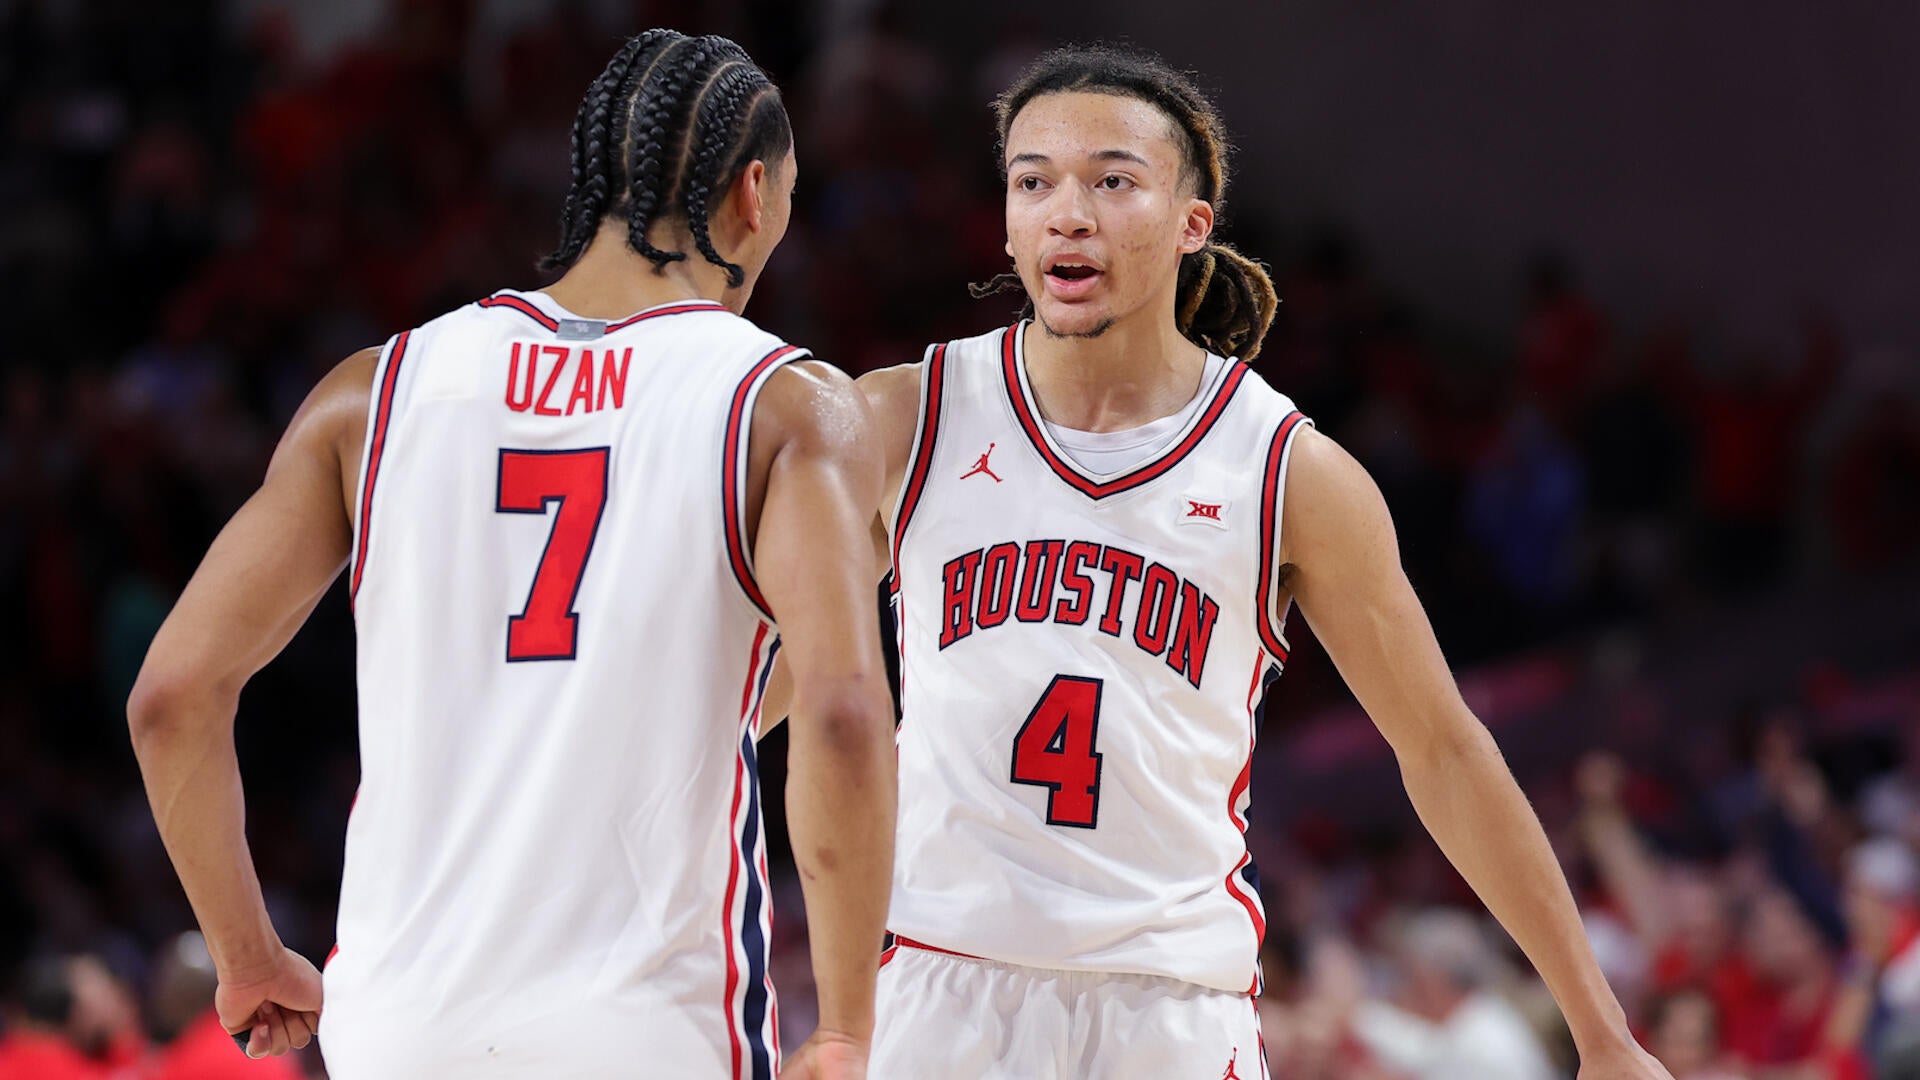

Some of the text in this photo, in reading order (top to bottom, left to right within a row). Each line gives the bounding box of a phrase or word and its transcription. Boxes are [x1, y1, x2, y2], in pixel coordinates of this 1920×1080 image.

[505, 342, 633, 416] UZAN
[495, 446, 610, 663] 7
[1186, 500, 1222, 521] XII
[939, 539, 1220, 690] HOUSTON
[1010, 673, 1103, 829] 4
